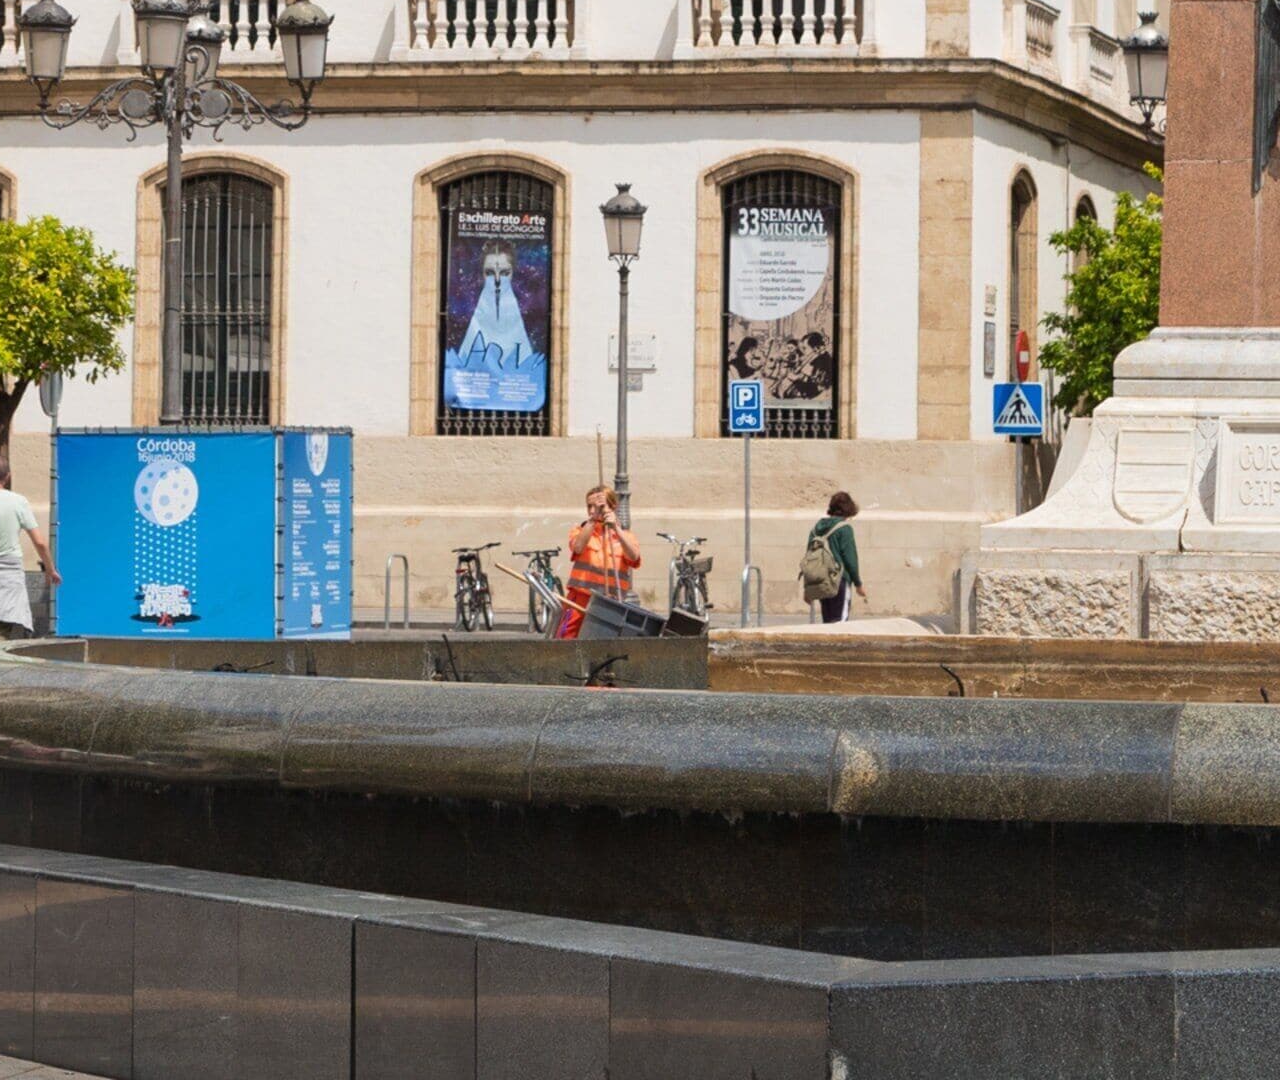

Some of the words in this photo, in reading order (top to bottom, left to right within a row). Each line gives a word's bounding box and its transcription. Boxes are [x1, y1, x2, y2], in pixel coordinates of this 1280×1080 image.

[458, 211, 520, 225] Bachillerato
[521, 213, 546, 226] Arte
[738, 207, 760, 236] 33
[760, 208, 825, 222] SEMANA
[760, 222, 828, 237] MUSICAL
[739, 388, 753, 406] P
[136, 437, 196, 452] Córdoba
